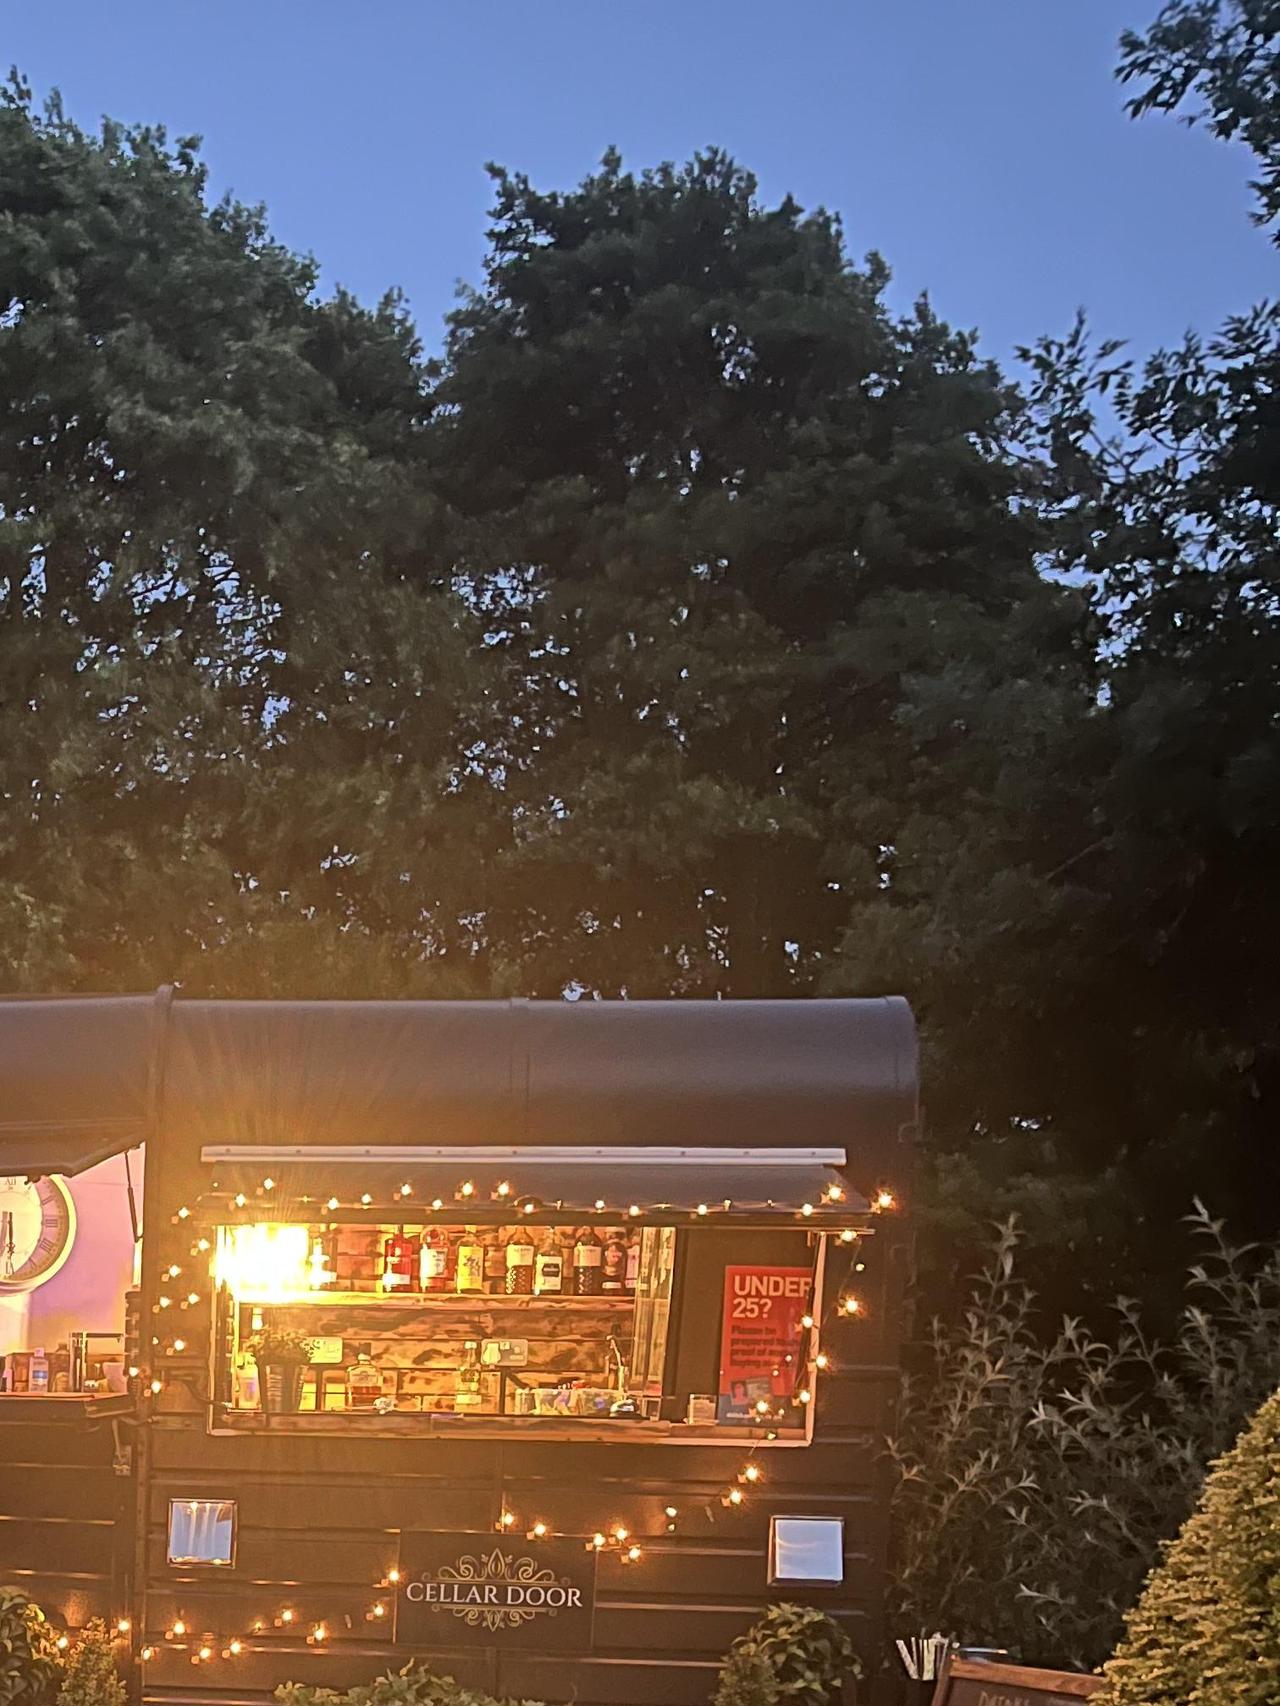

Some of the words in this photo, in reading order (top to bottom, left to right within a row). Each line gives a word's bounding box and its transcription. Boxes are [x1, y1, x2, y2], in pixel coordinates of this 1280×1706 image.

[734, 1275, 812, 1298] UNDER
[732, 1297, 772, 1318] 25?
[406, 1582, 499, 1604] CELLAR
[506, 1586, 583, 1608] DOOR
